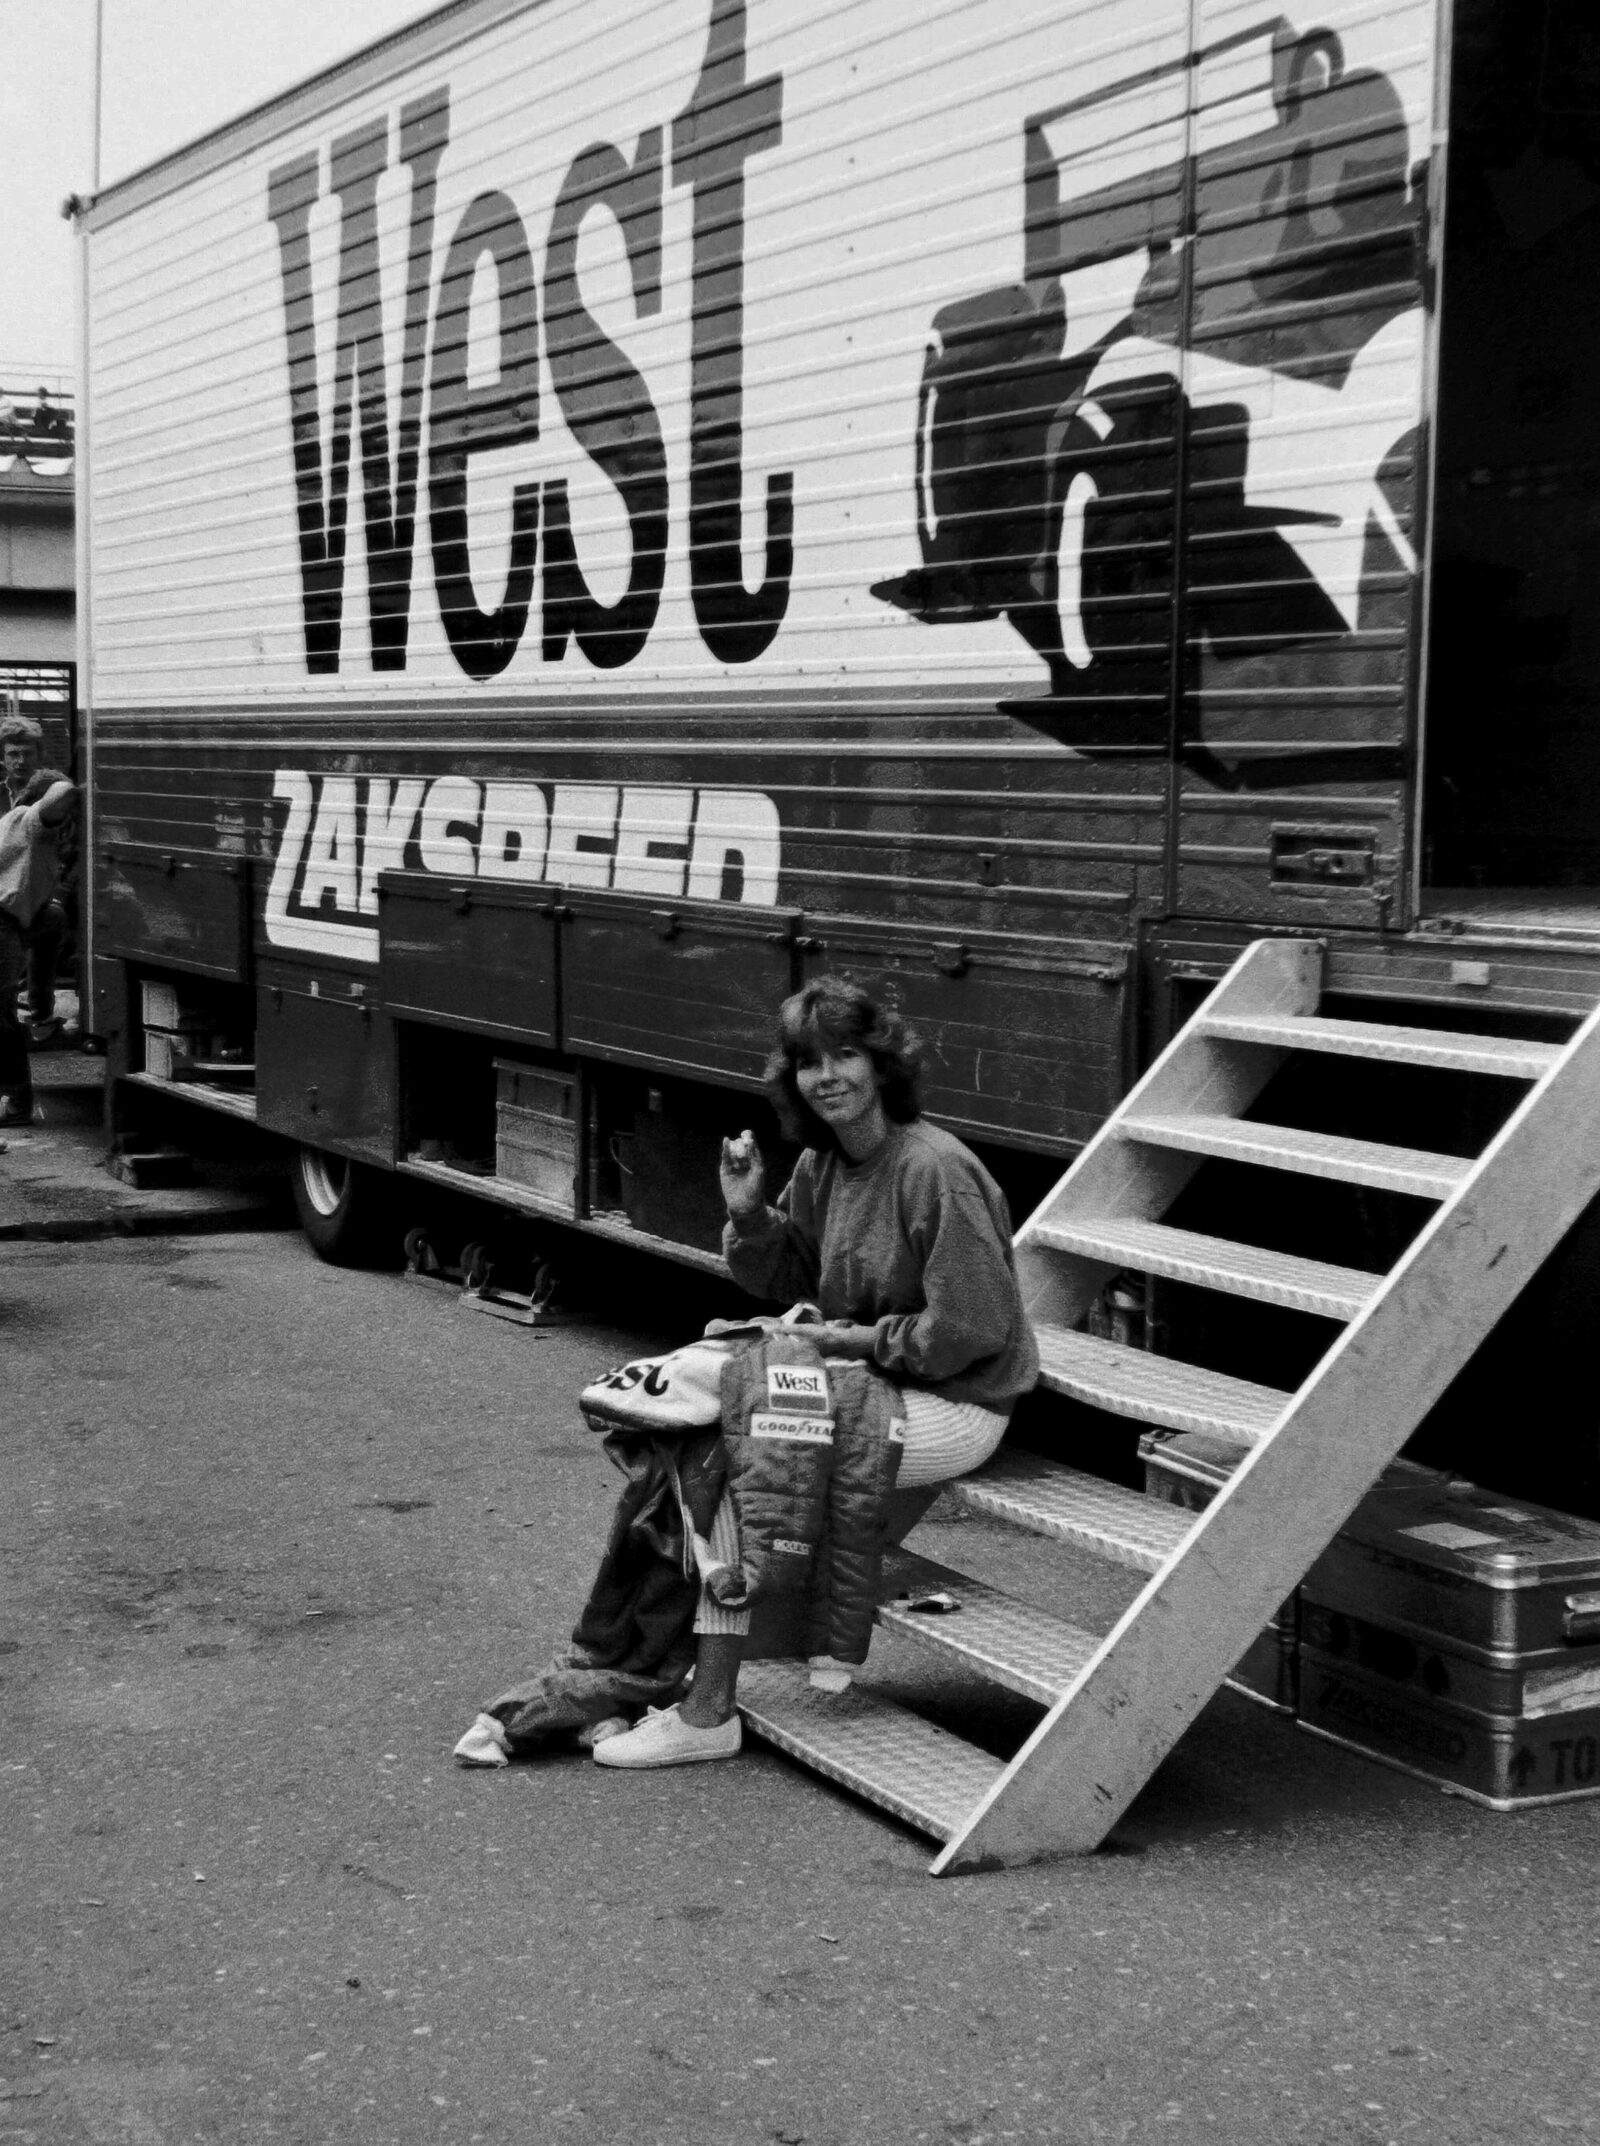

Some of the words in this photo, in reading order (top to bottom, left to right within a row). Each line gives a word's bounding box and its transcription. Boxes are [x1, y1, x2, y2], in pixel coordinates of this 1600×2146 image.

[267, 0, 795, 681] West
[773, 1372, 822, 1393] West
[757, 1420, 831, 1436] GOODYEA
